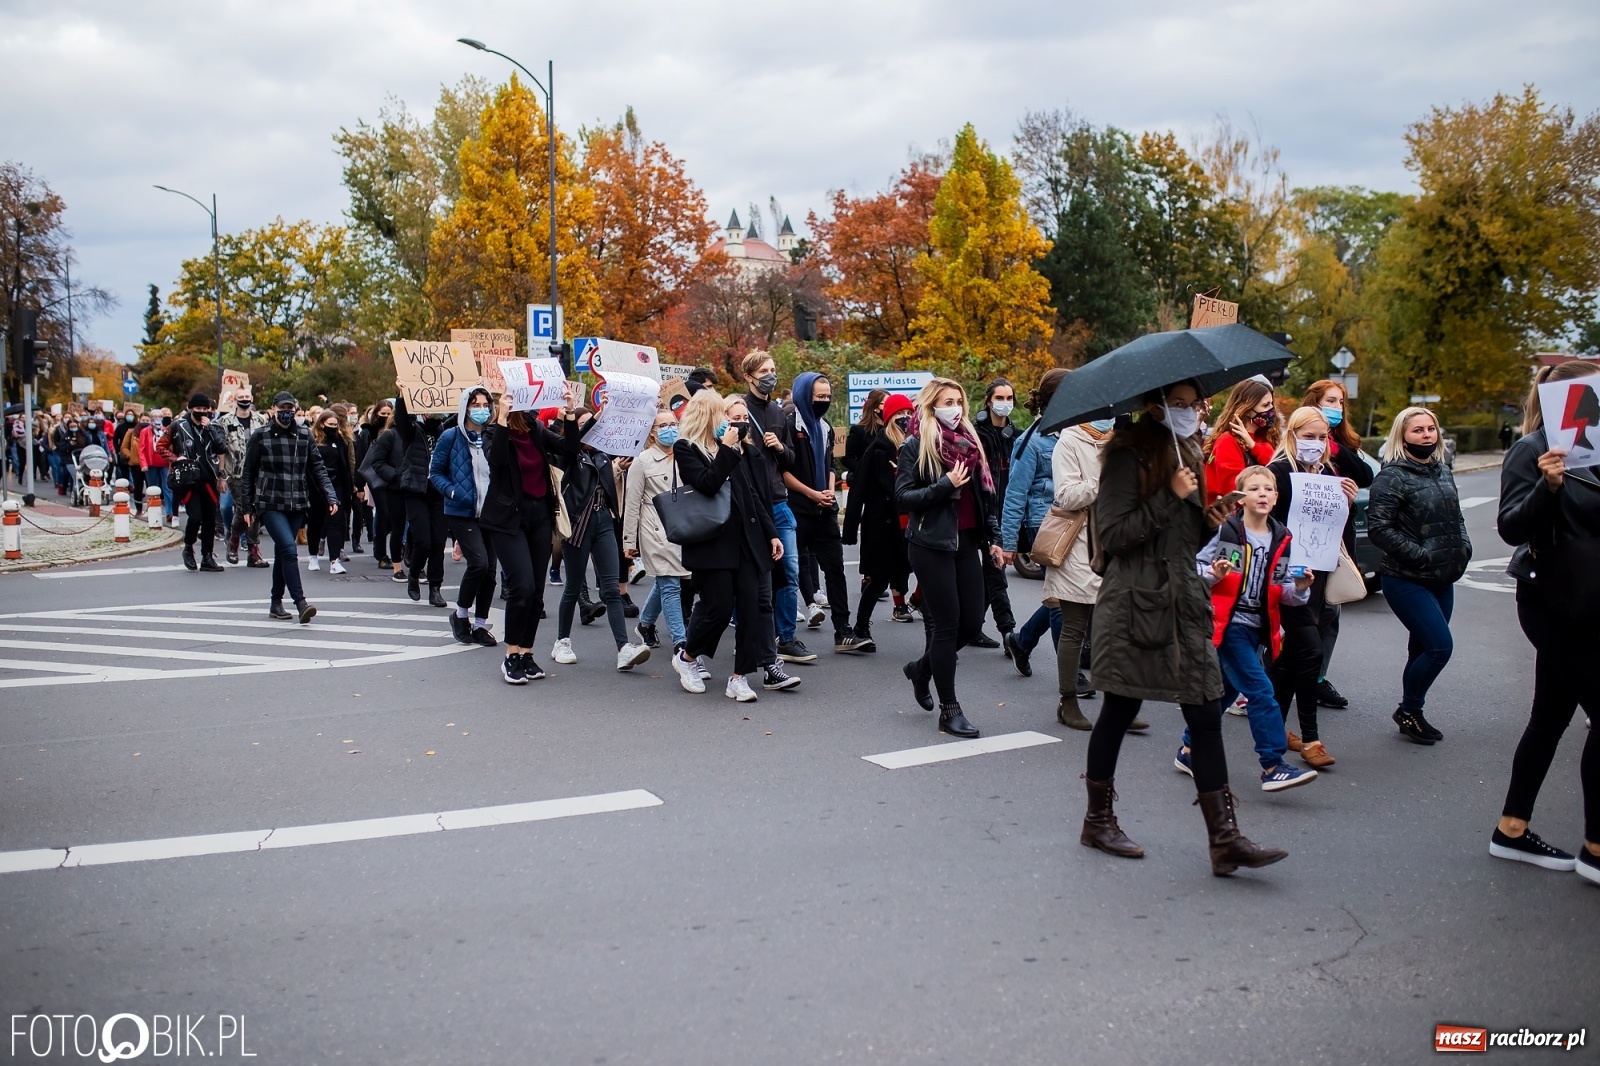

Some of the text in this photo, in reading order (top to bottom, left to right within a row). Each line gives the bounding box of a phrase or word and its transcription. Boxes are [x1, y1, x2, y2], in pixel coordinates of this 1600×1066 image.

[1199, 297, 1235, 318] PIEKŁO
[467, 331, 489, 341] JAREK
[404, 344, 454, 366] WARA
[420, 366, 454, 387] OD
[503, 364, 562, 381] MOJE CIAŁO
[852, 376, 916, 387] Urząd Miasta
[640, 384, 648, 395] Z
[636, 418, 650, 428] NIE
[1304, 482, 1334, 493] MILION NAS
[1302, 489, 1313, 498] TAK
[1314, 491, 1331, 501] TERAZ
[1302, 505, 1311, 515] SIĘ
